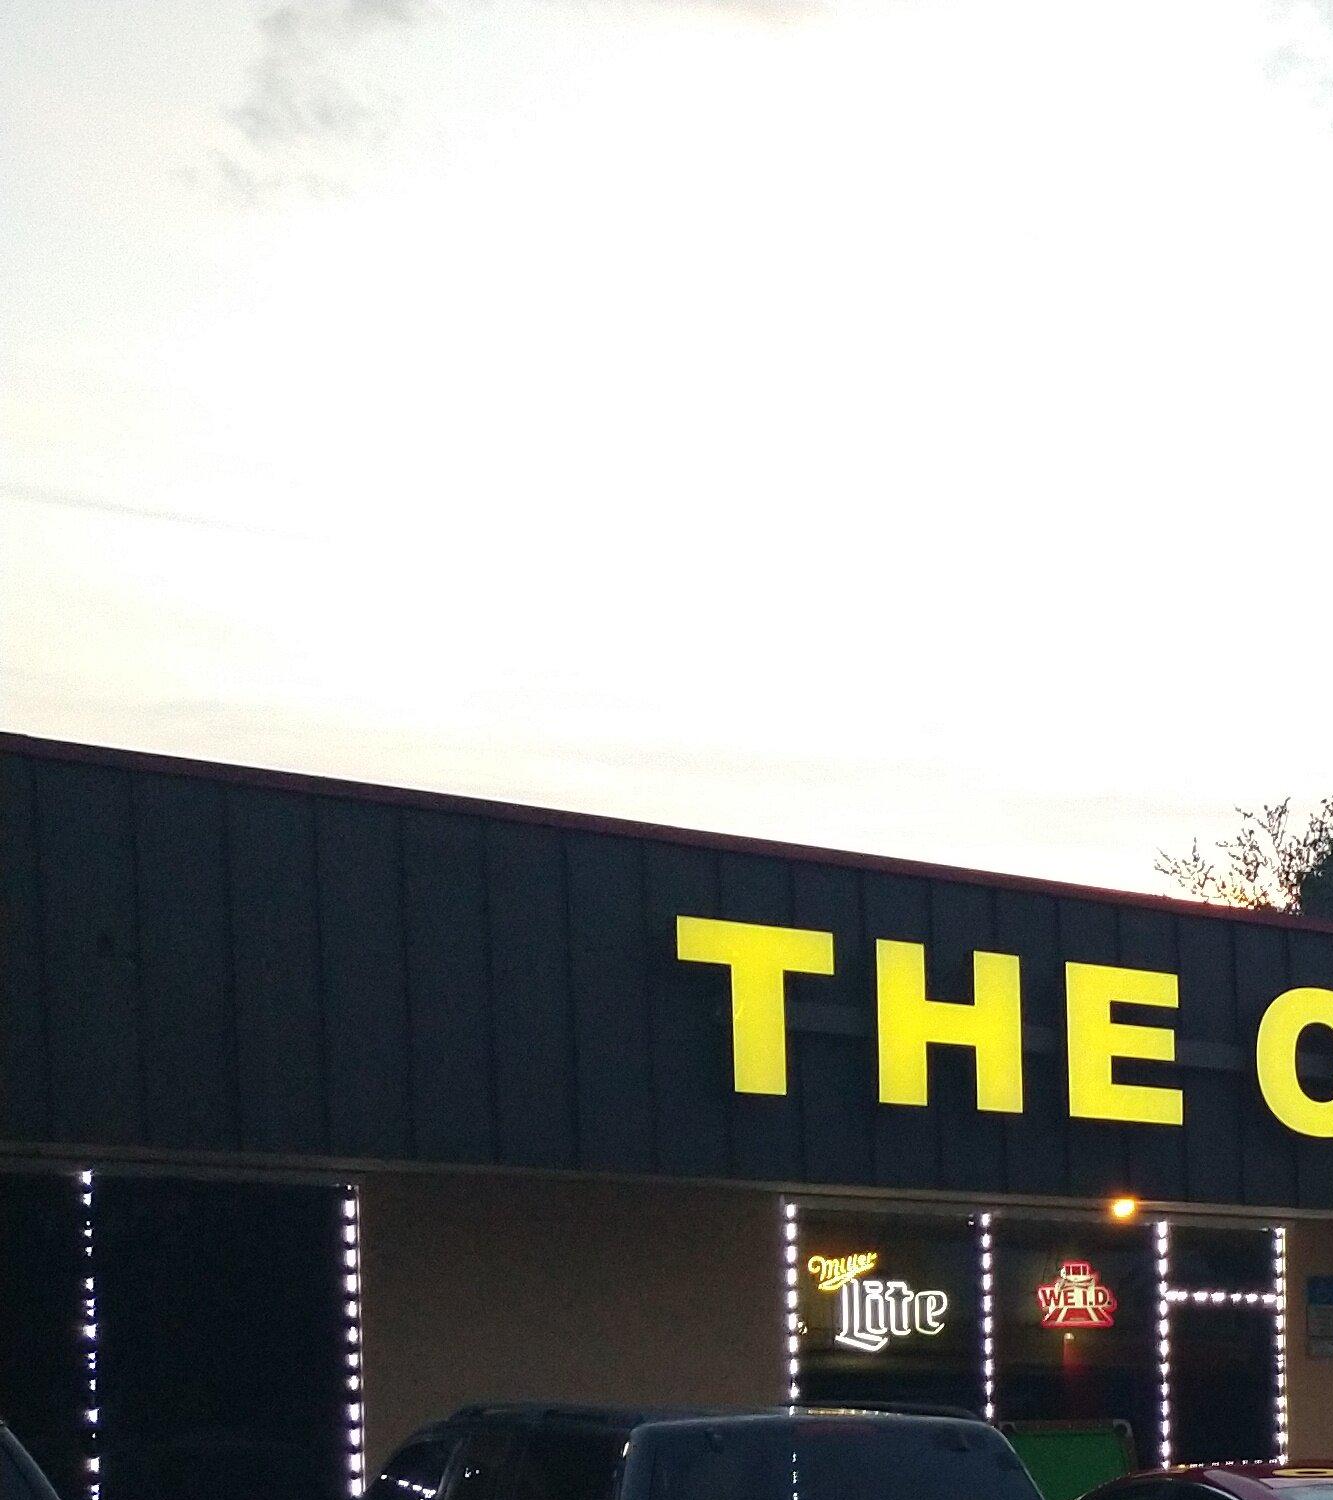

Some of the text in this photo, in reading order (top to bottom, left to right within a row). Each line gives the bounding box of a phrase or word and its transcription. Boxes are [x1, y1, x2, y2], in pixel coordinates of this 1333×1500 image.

[676, 915, 1184, 1126] THE
[808, 1252, 878, 1286] Miller
[834, 1278, 949, 1352] Lite
[1041, 1288, 1076, 1308] WE
